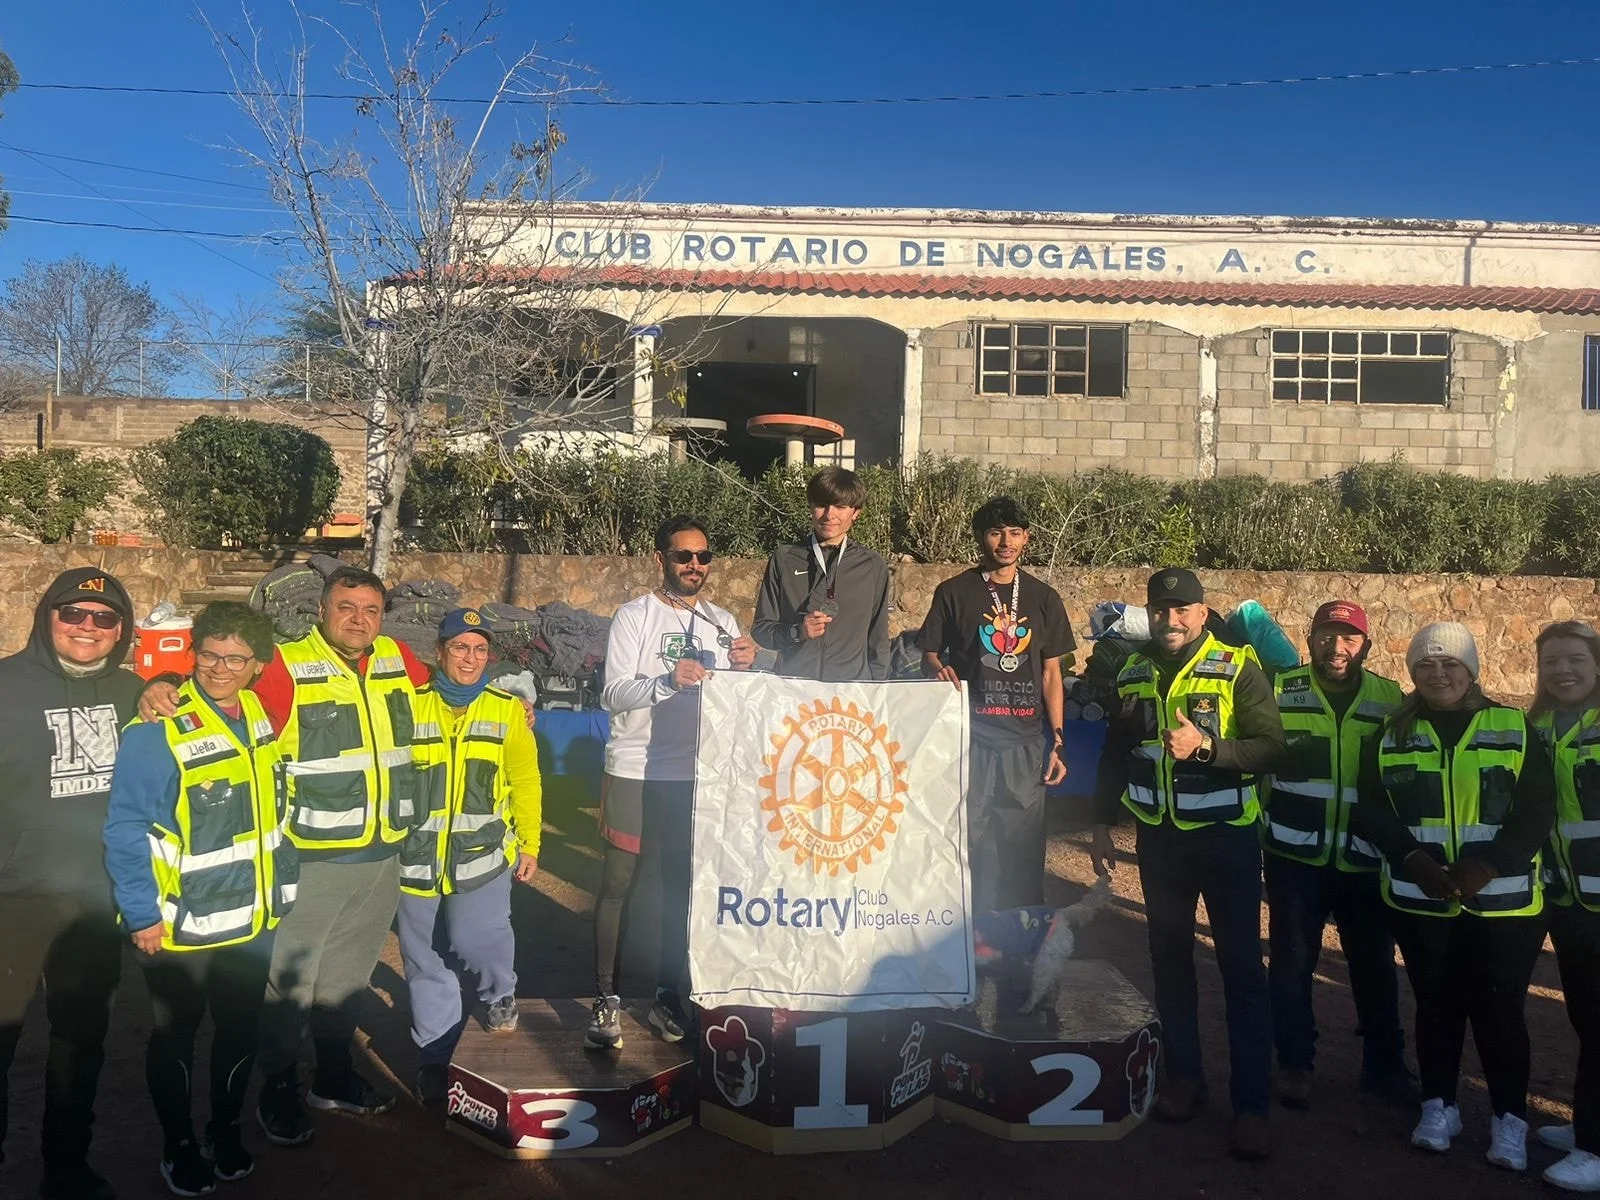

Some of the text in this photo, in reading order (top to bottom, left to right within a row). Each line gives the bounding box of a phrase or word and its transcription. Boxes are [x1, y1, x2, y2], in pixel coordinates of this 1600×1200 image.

[554, 231, 652, 260] CLUB
[683, 234, 868, 265] ROTARIO
[900, 240, 945, 266] DE
[1216, 247, 1261, 273] A.
[1295, 250, 1331, 274] C.
[1012, 707, 1034, 717] VIDAS
[1293, 694, 1306, 704] K9
[44, 704, 118, 776] N
[808, 714, 867, 737] ROTARY
[783, 813, 885, 857] INTERNATIONAL
[716, 886, 852, 937] Rotary
[858, 888, 888, 906] Club
[858, 910, 953, 930] Nogales A.C
[794, 1017, 868, 1129] 1
[1028, 1053, 1104, 1125] 2
[464, 1098, 496, 1119] PONTE
[517, 1098, 599, 1150] 3
